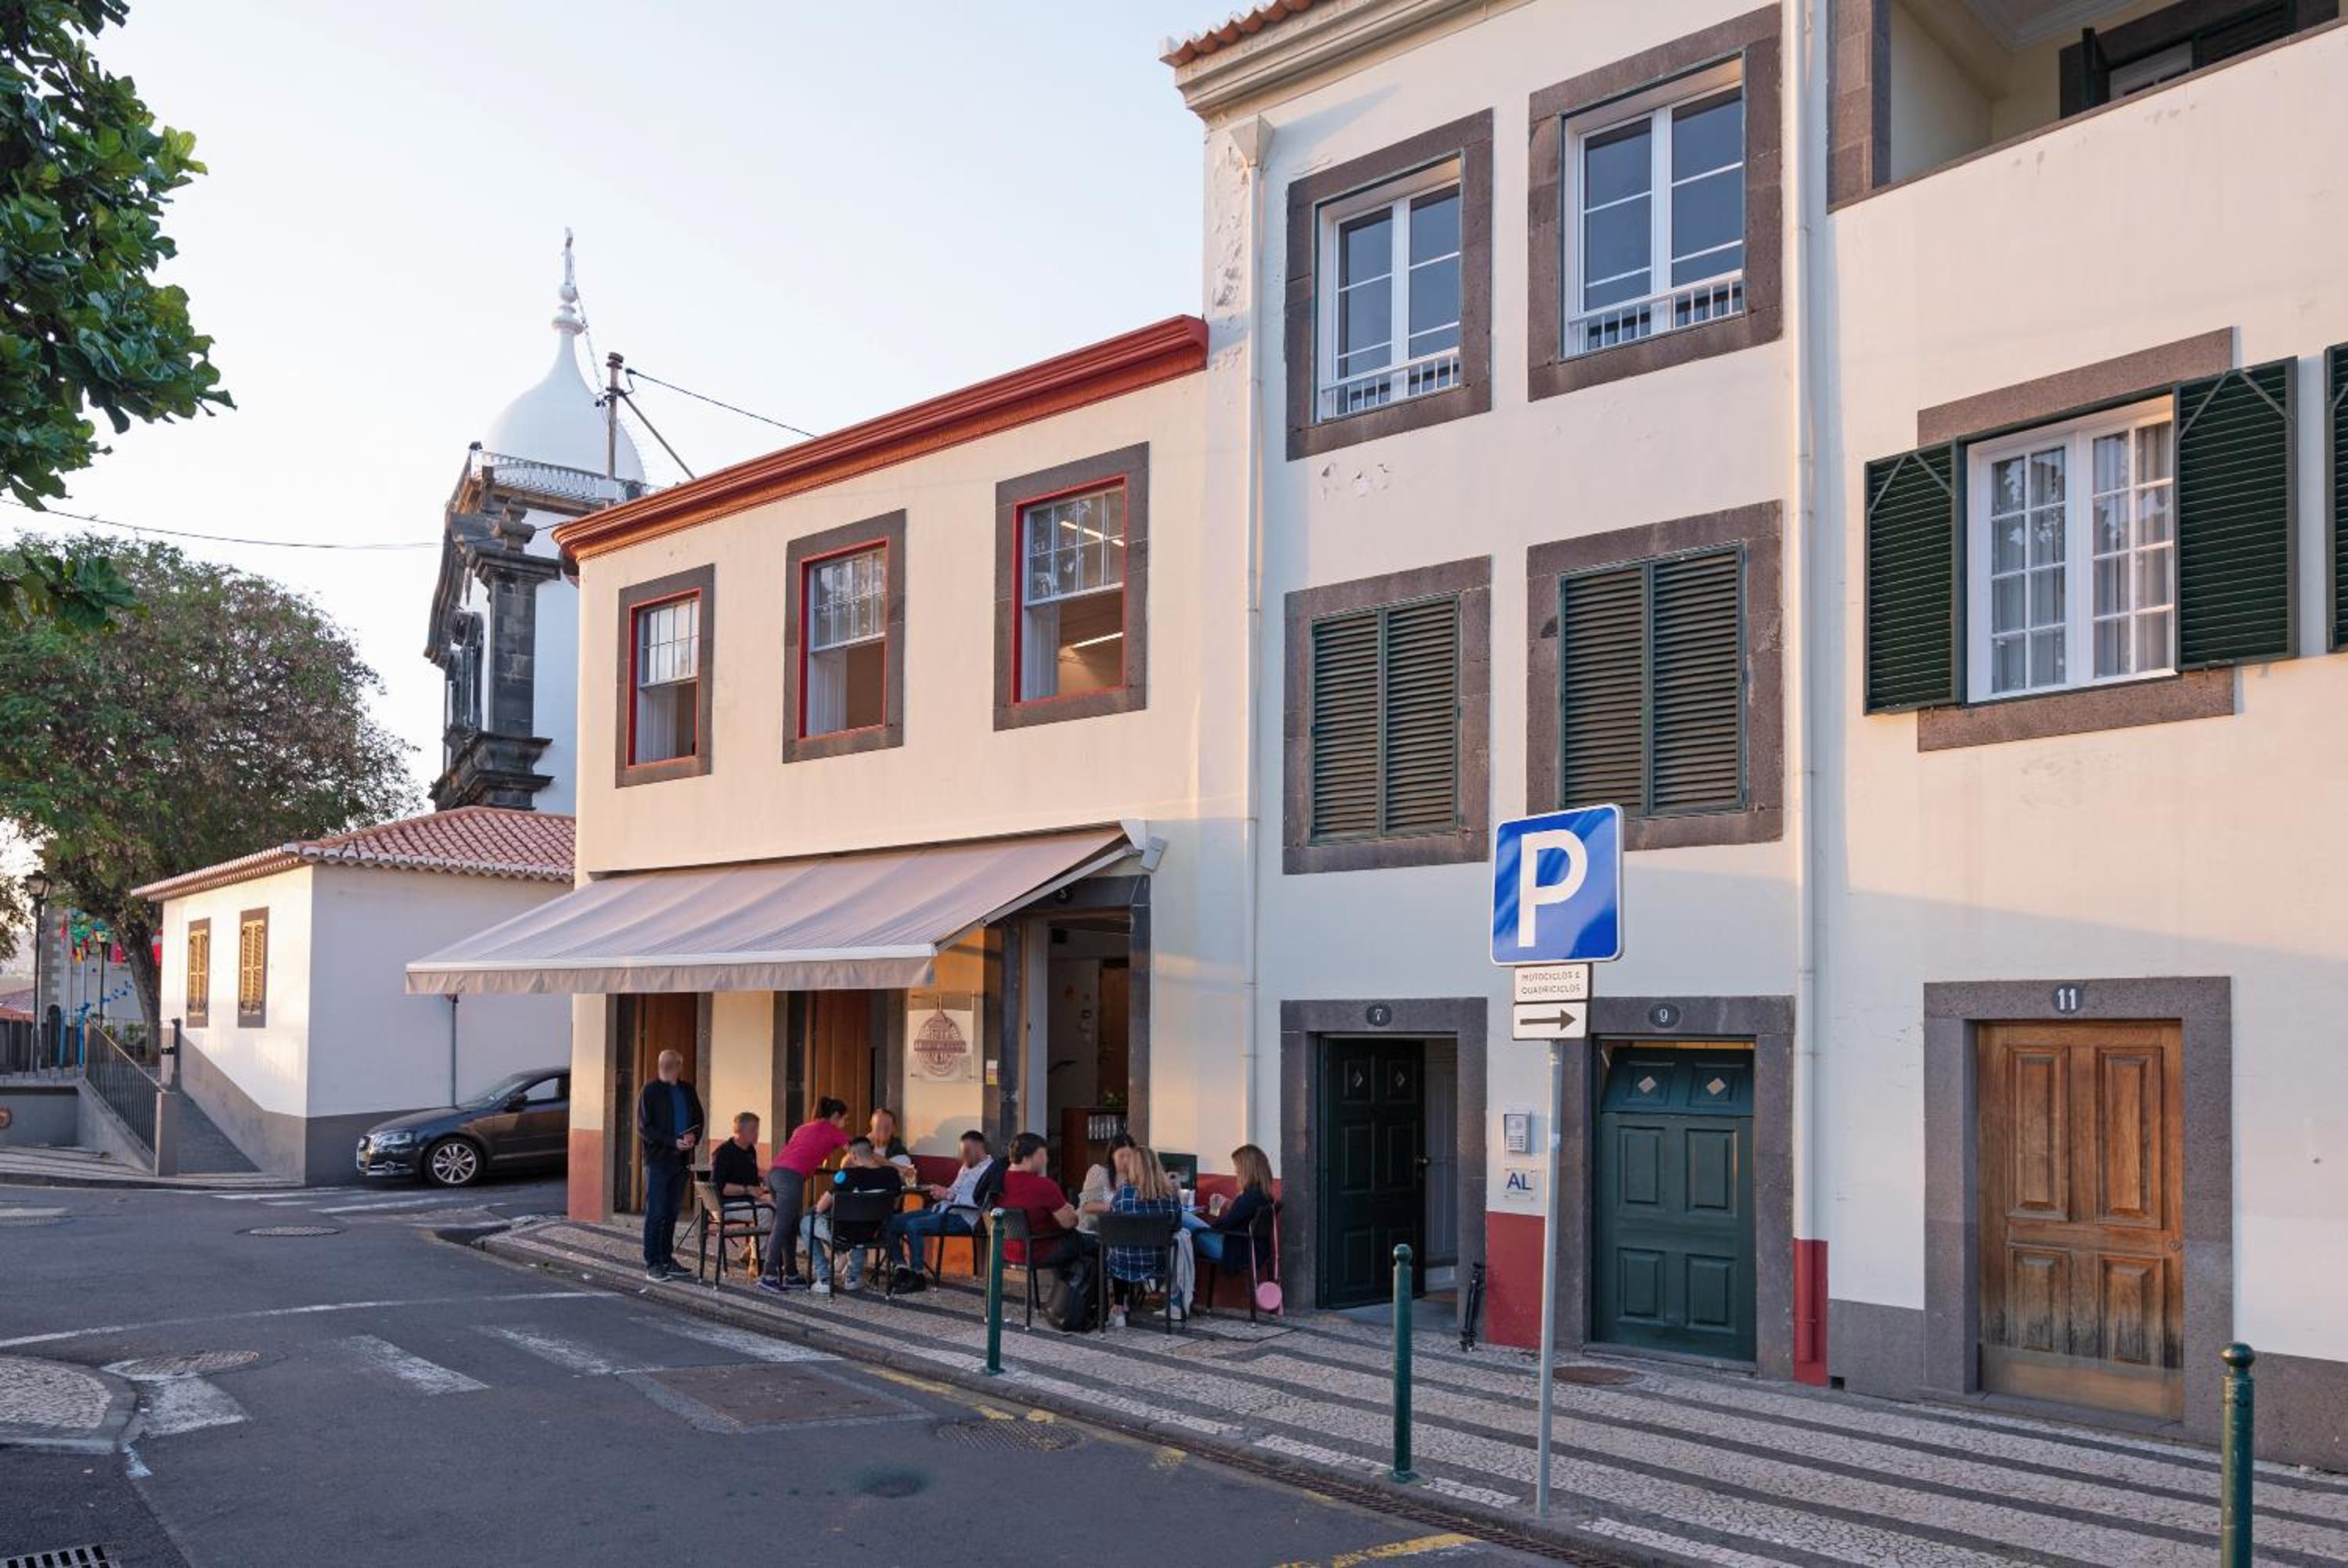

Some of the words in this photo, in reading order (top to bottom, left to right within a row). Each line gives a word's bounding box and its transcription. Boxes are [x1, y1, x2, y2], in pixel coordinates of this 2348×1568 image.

[1518, 829, 1588, 948] P
[1521, 971, 1572, 982] MOTOCICLOS
[1521, 984, 1580, 994] QUADRICICLOS
[2058, 988, 2076, 1010] 11
[1374, 1009, 1383, 1021] 7
[1659, 1009, 1668, 1023] 9
[1507, 1172, 1533, 1190] AL
